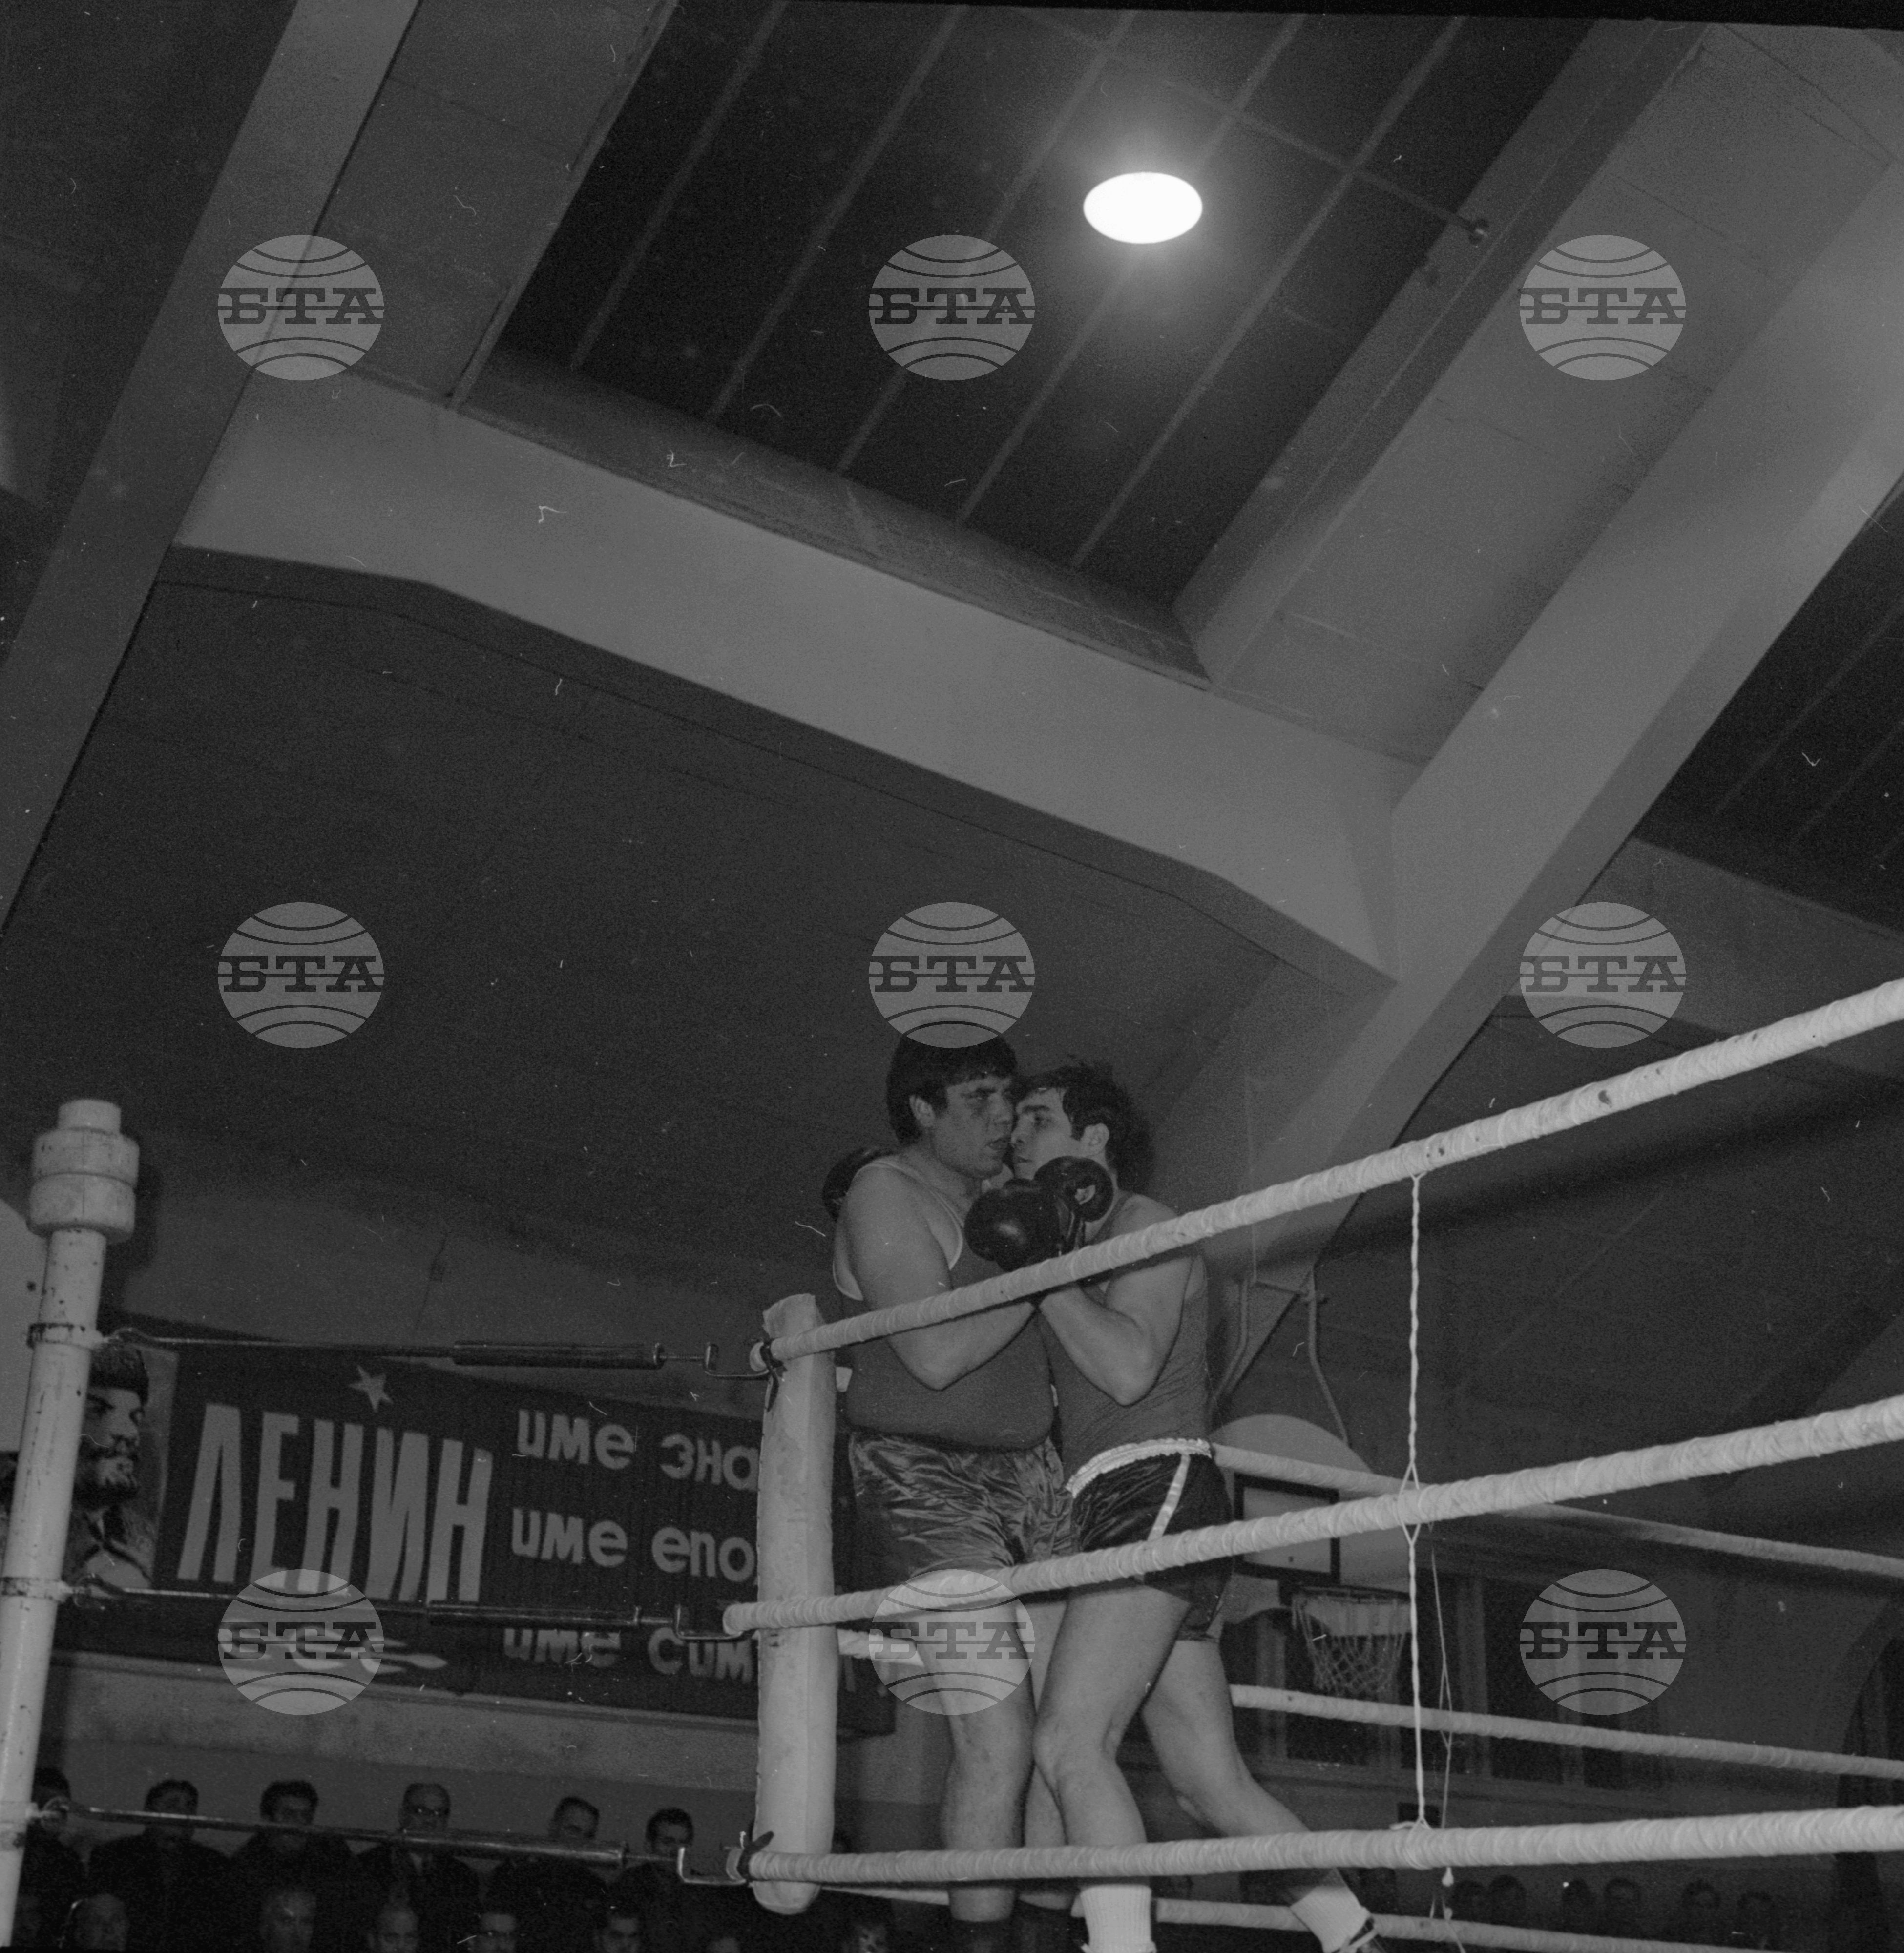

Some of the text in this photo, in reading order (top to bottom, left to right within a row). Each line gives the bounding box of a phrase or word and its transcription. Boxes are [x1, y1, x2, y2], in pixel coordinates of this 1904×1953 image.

[517, 1410, 759, 1492] име зна
[178, 1402, 493, 1602] ЛЕНИН
[512, 1508, 758, 1585] име епо
[648, 1627, 753, 1683] сим
